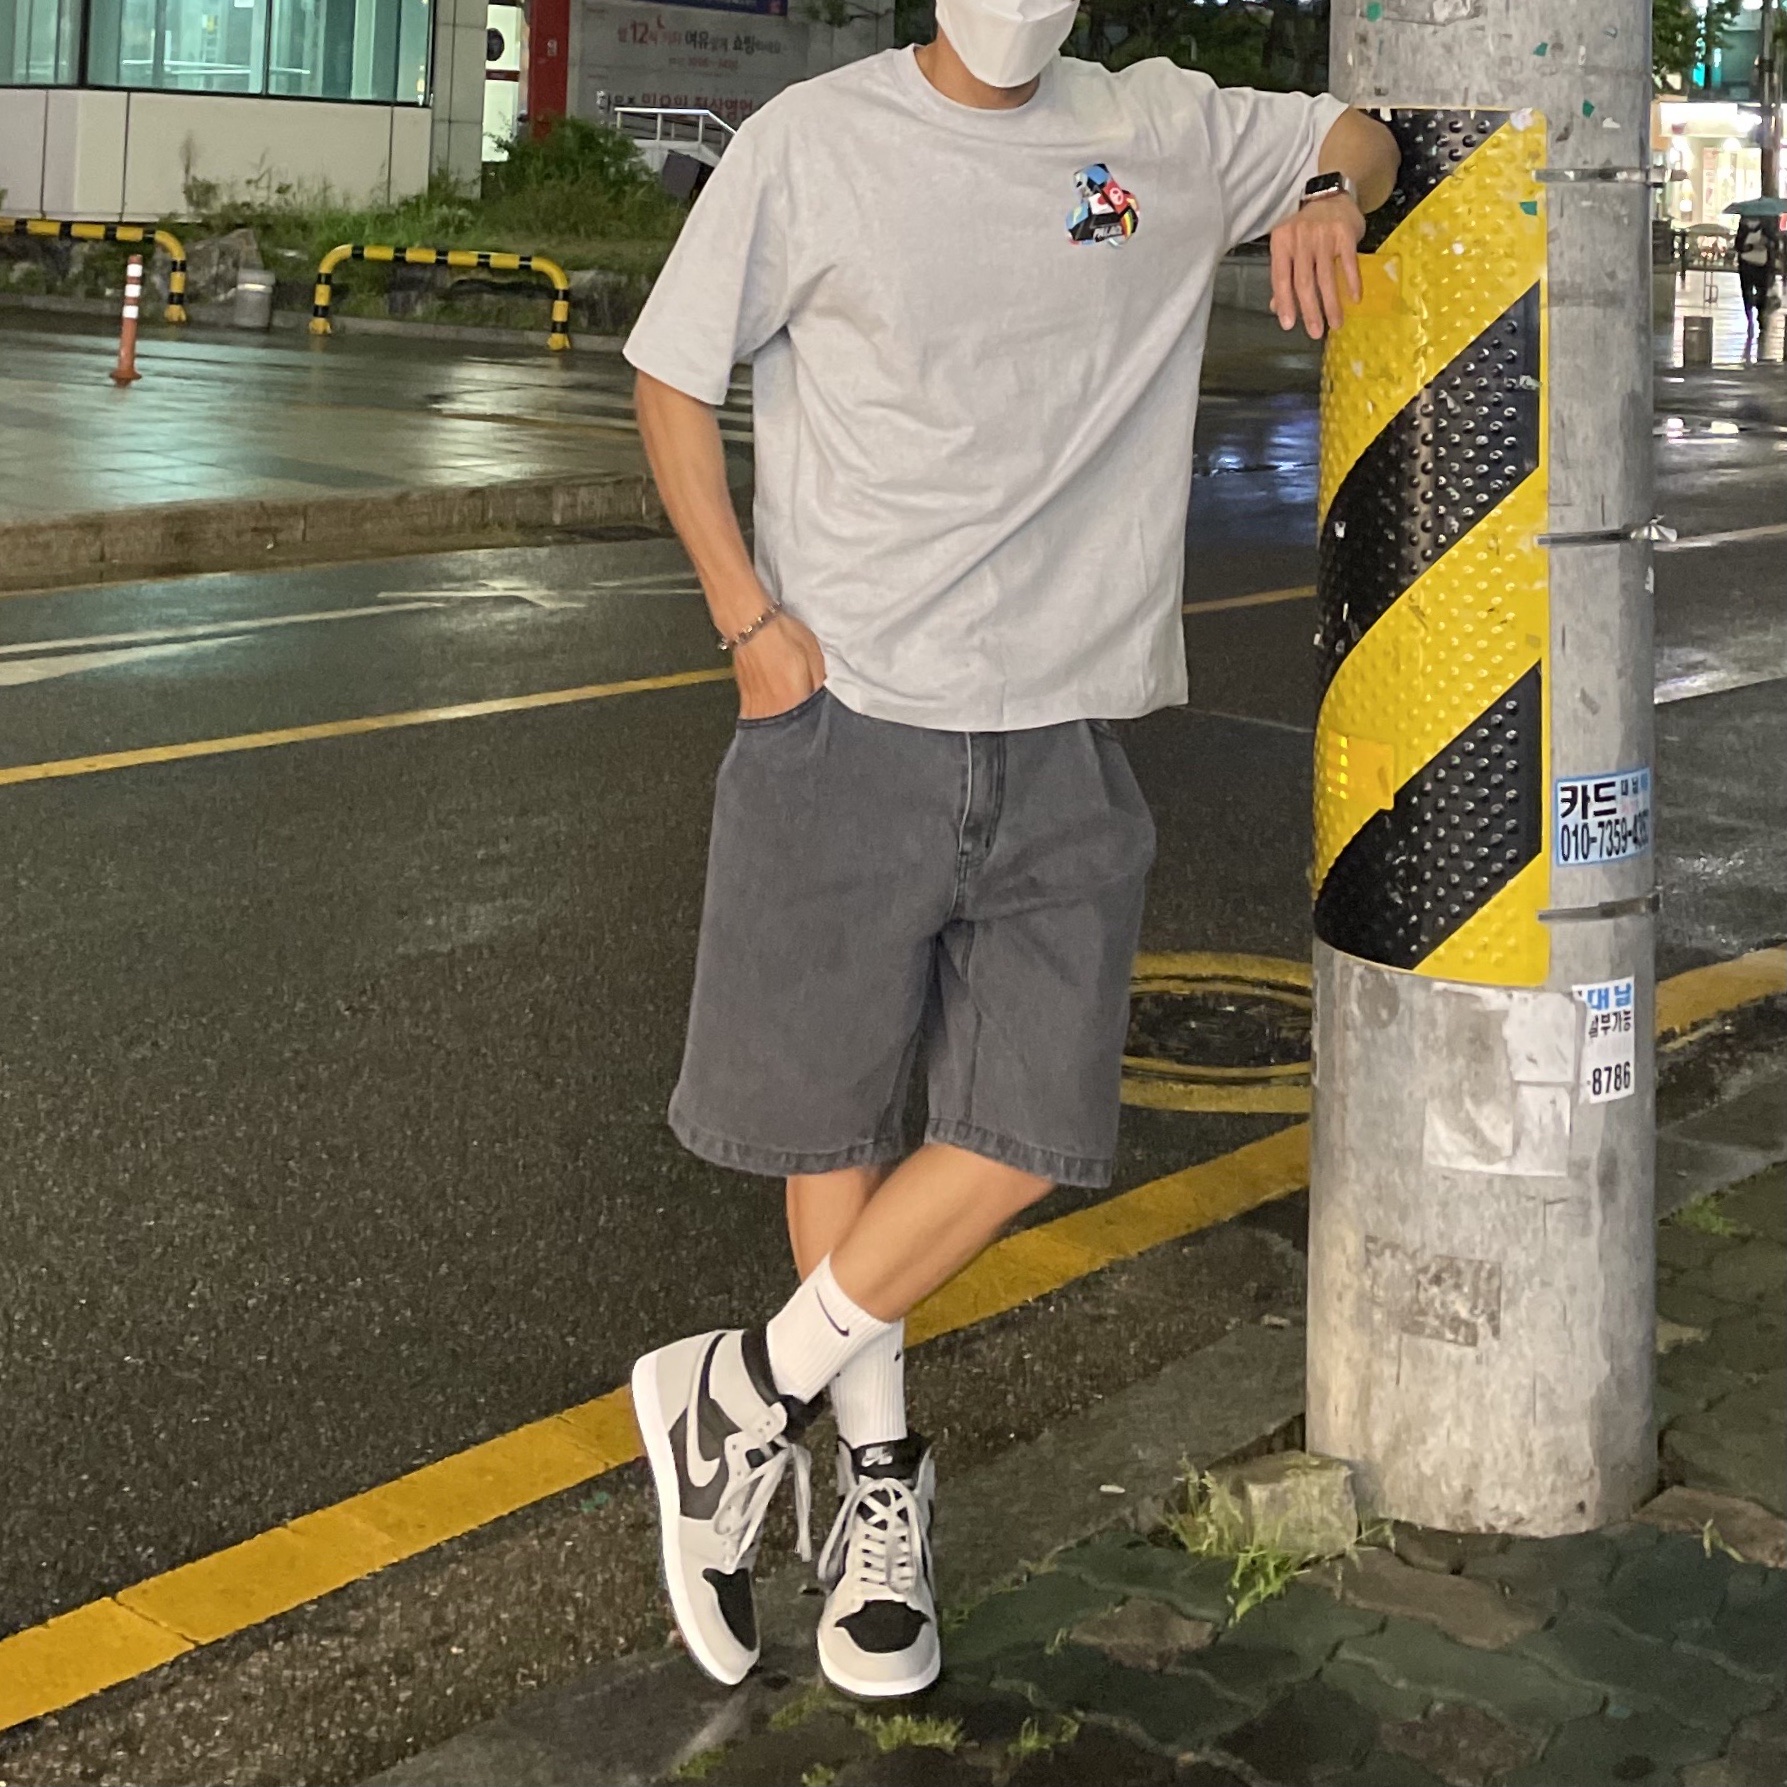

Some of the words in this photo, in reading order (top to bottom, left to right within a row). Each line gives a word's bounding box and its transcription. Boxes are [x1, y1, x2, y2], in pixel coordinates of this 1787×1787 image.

[1560, 781, 1617, 820] 카드
[1587, 983, 1632, 1010] 대납
[1592, 1061, 1631, 1095] 8786
